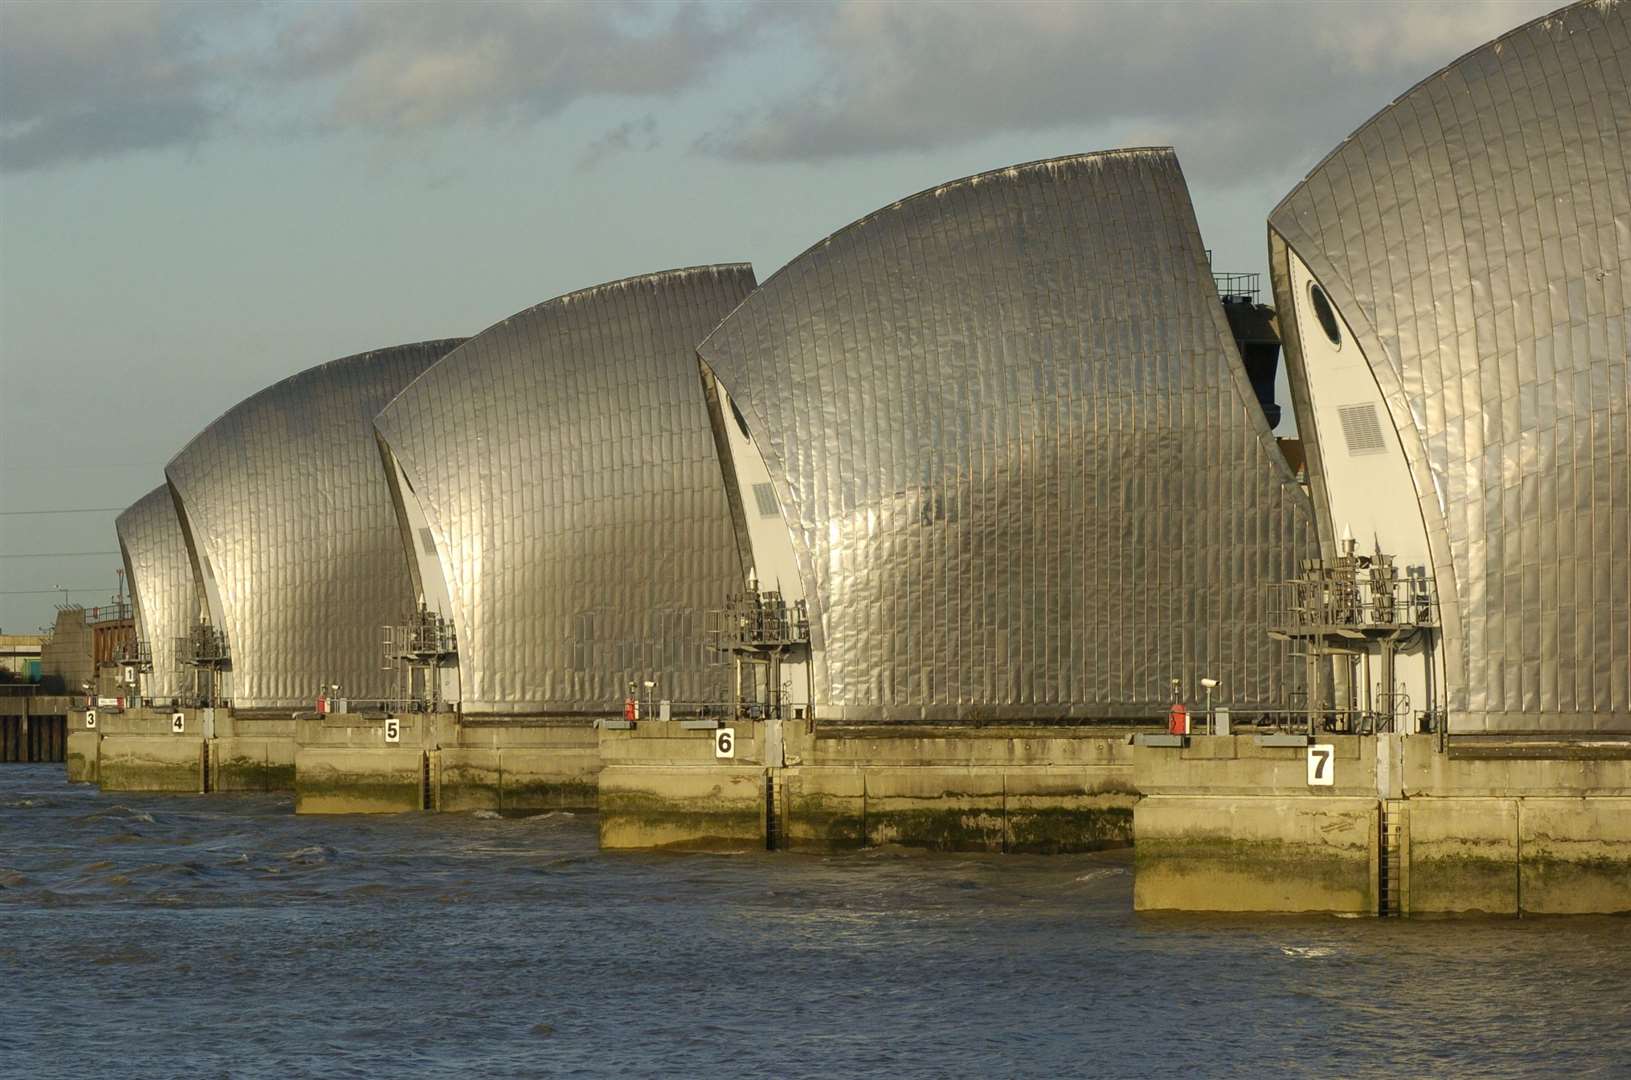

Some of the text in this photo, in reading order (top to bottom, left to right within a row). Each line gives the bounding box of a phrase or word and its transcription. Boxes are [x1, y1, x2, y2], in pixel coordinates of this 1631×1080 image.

[88, 713, 94, 725] 3
[174, 716, 182, 729] 4
[388, 722, 397, 738] 5
[718, 732, 732, 753] 6
[1311, 750, 1330, 780] 7
